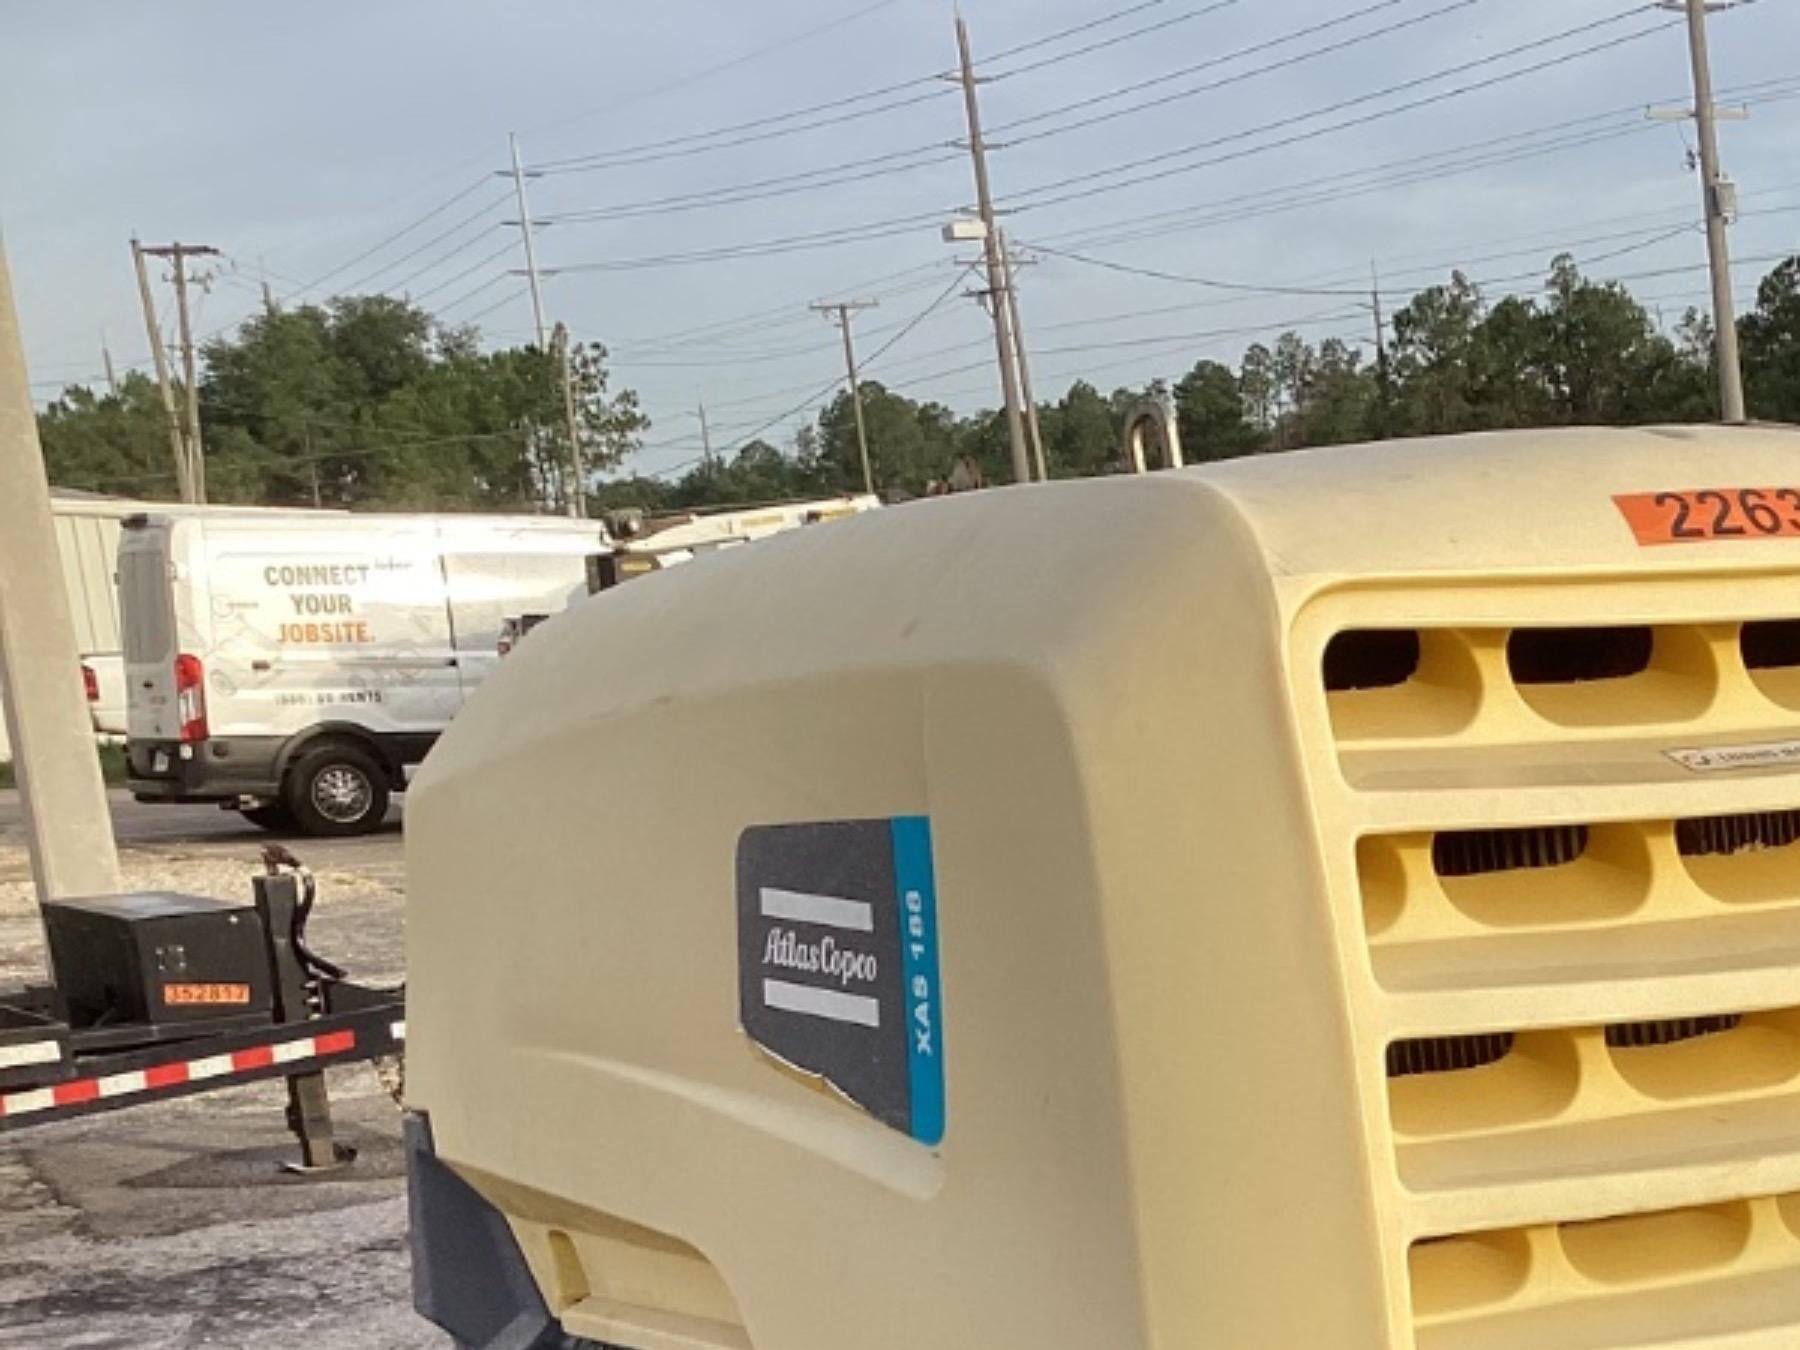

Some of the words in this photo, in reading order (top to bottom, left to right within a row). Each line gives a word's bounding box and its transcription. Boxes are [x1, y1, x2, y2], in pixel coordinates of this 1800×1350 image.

[264, 565, 370, 586] CONNECT
[290, 594, 353, 615] YOUR
[277, 622, 376, 643] JOBSITE.
[911, 975, 933, 1056] XAS
